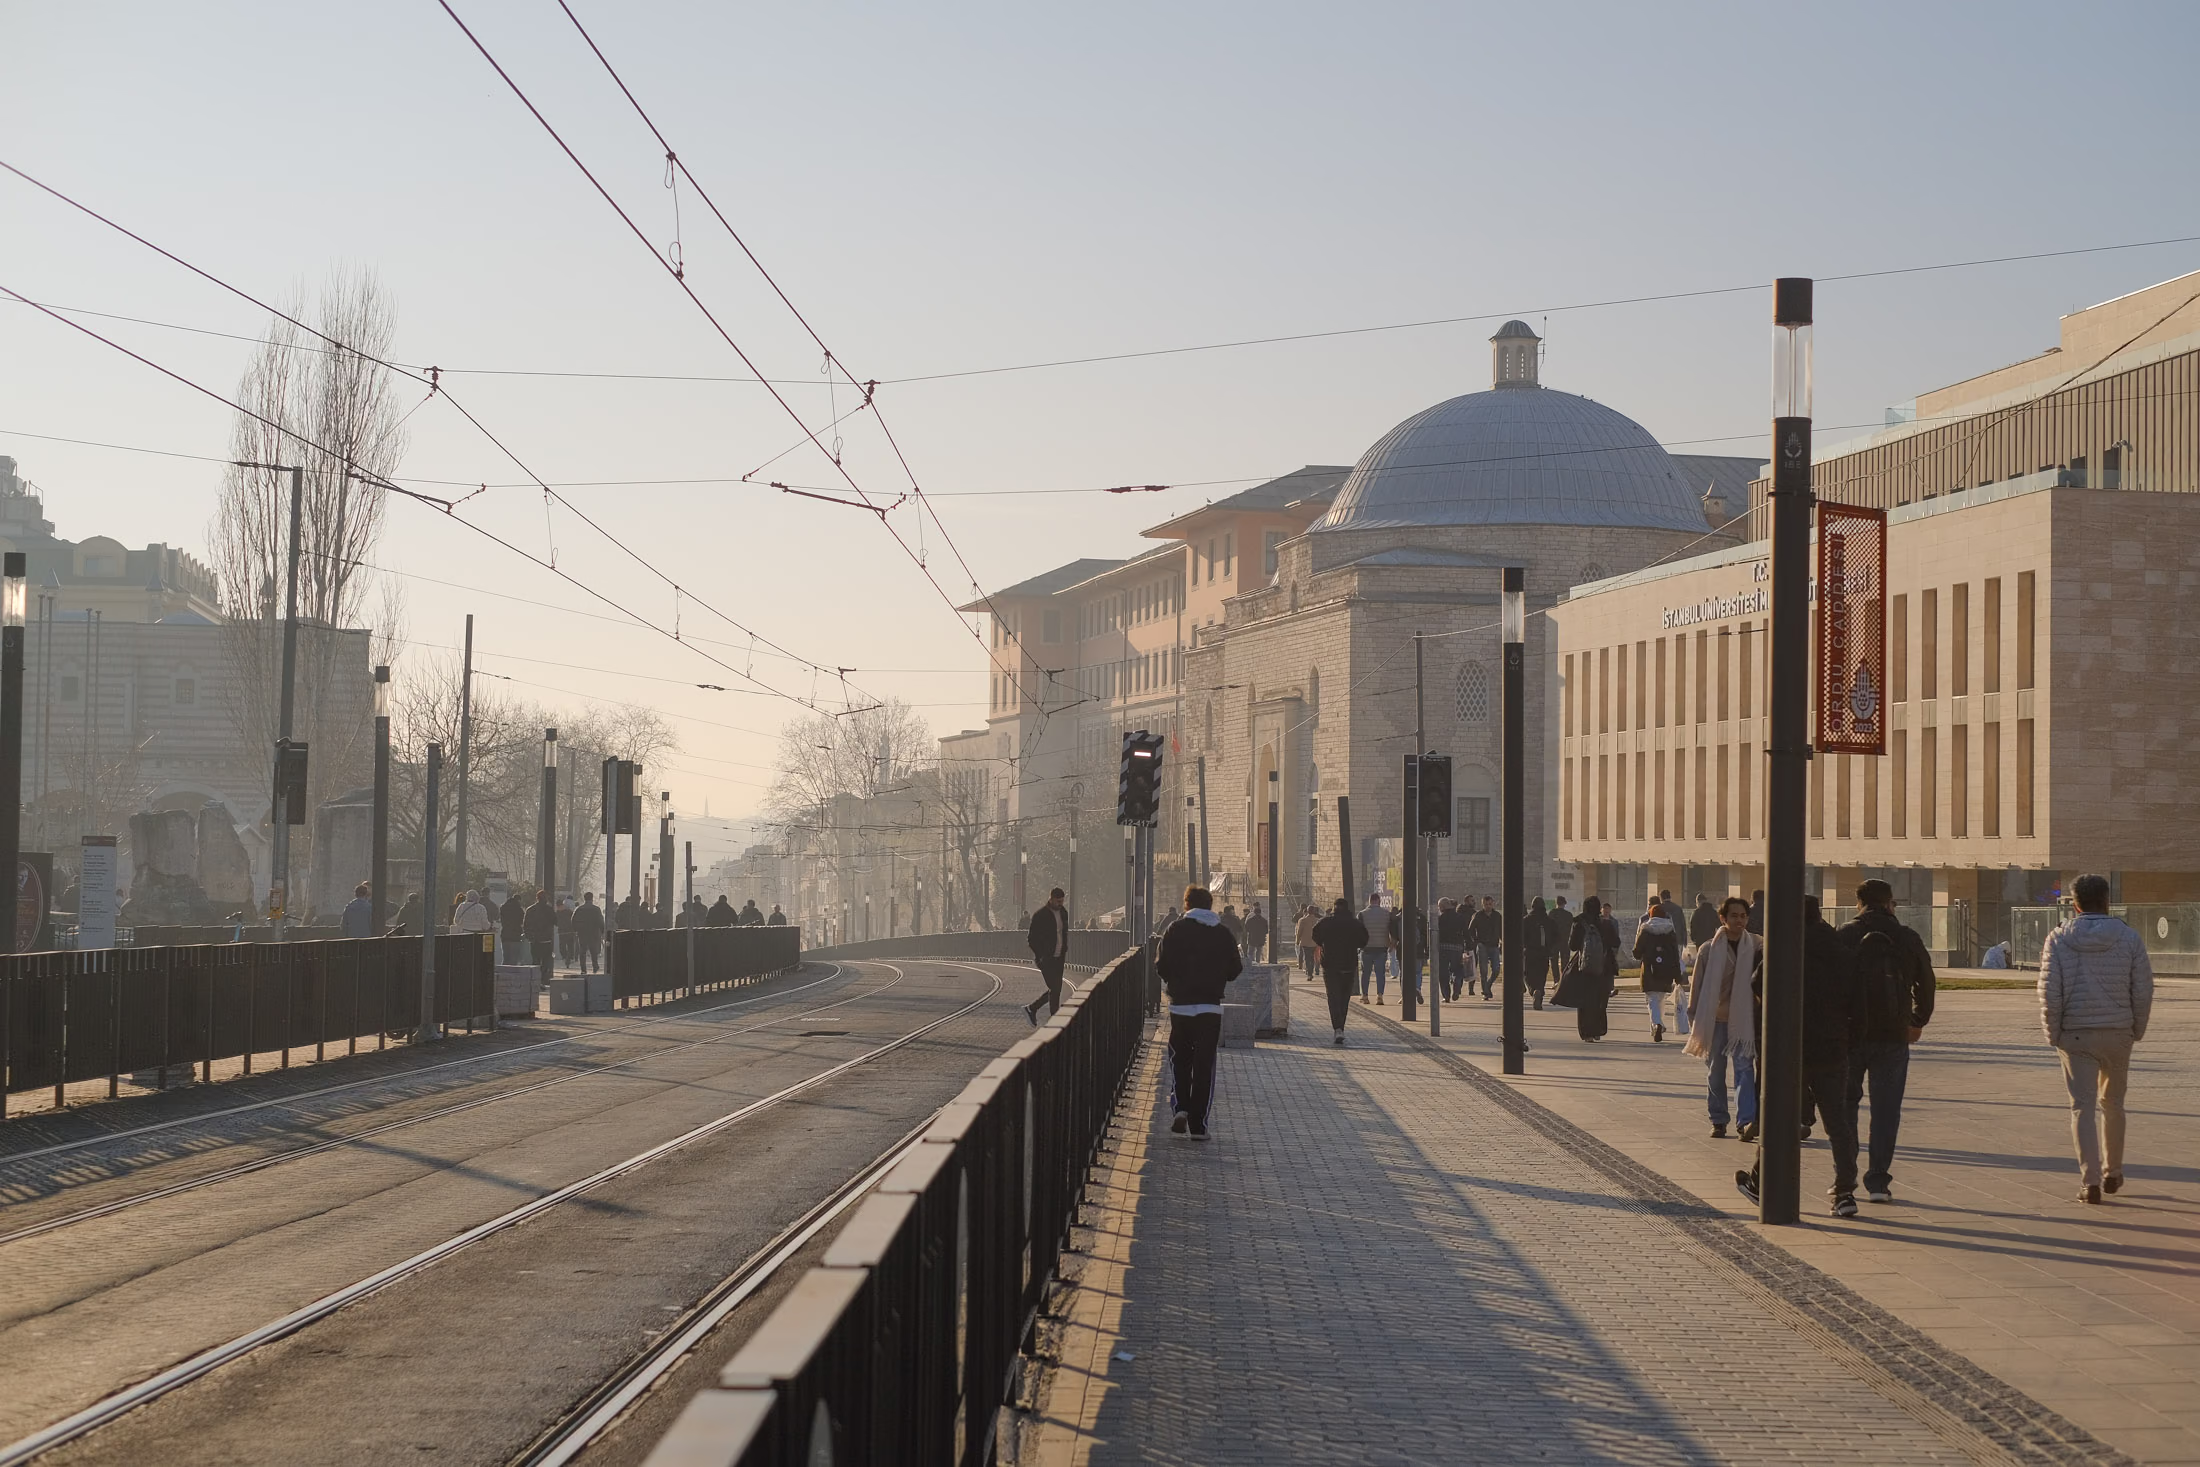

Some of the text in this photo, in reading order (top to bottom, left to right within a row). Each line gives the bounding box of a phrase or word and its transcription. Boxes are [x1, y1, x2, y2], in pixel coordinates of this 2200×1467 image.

[1751, 561, 1769, 582] T.C.
[1662, 605, 1702, 629] İSTANBUL
[1702, 588, 1760, 620] ÜNİVERSİTESİ
[1831, 664, 1843, 732] ORDU
